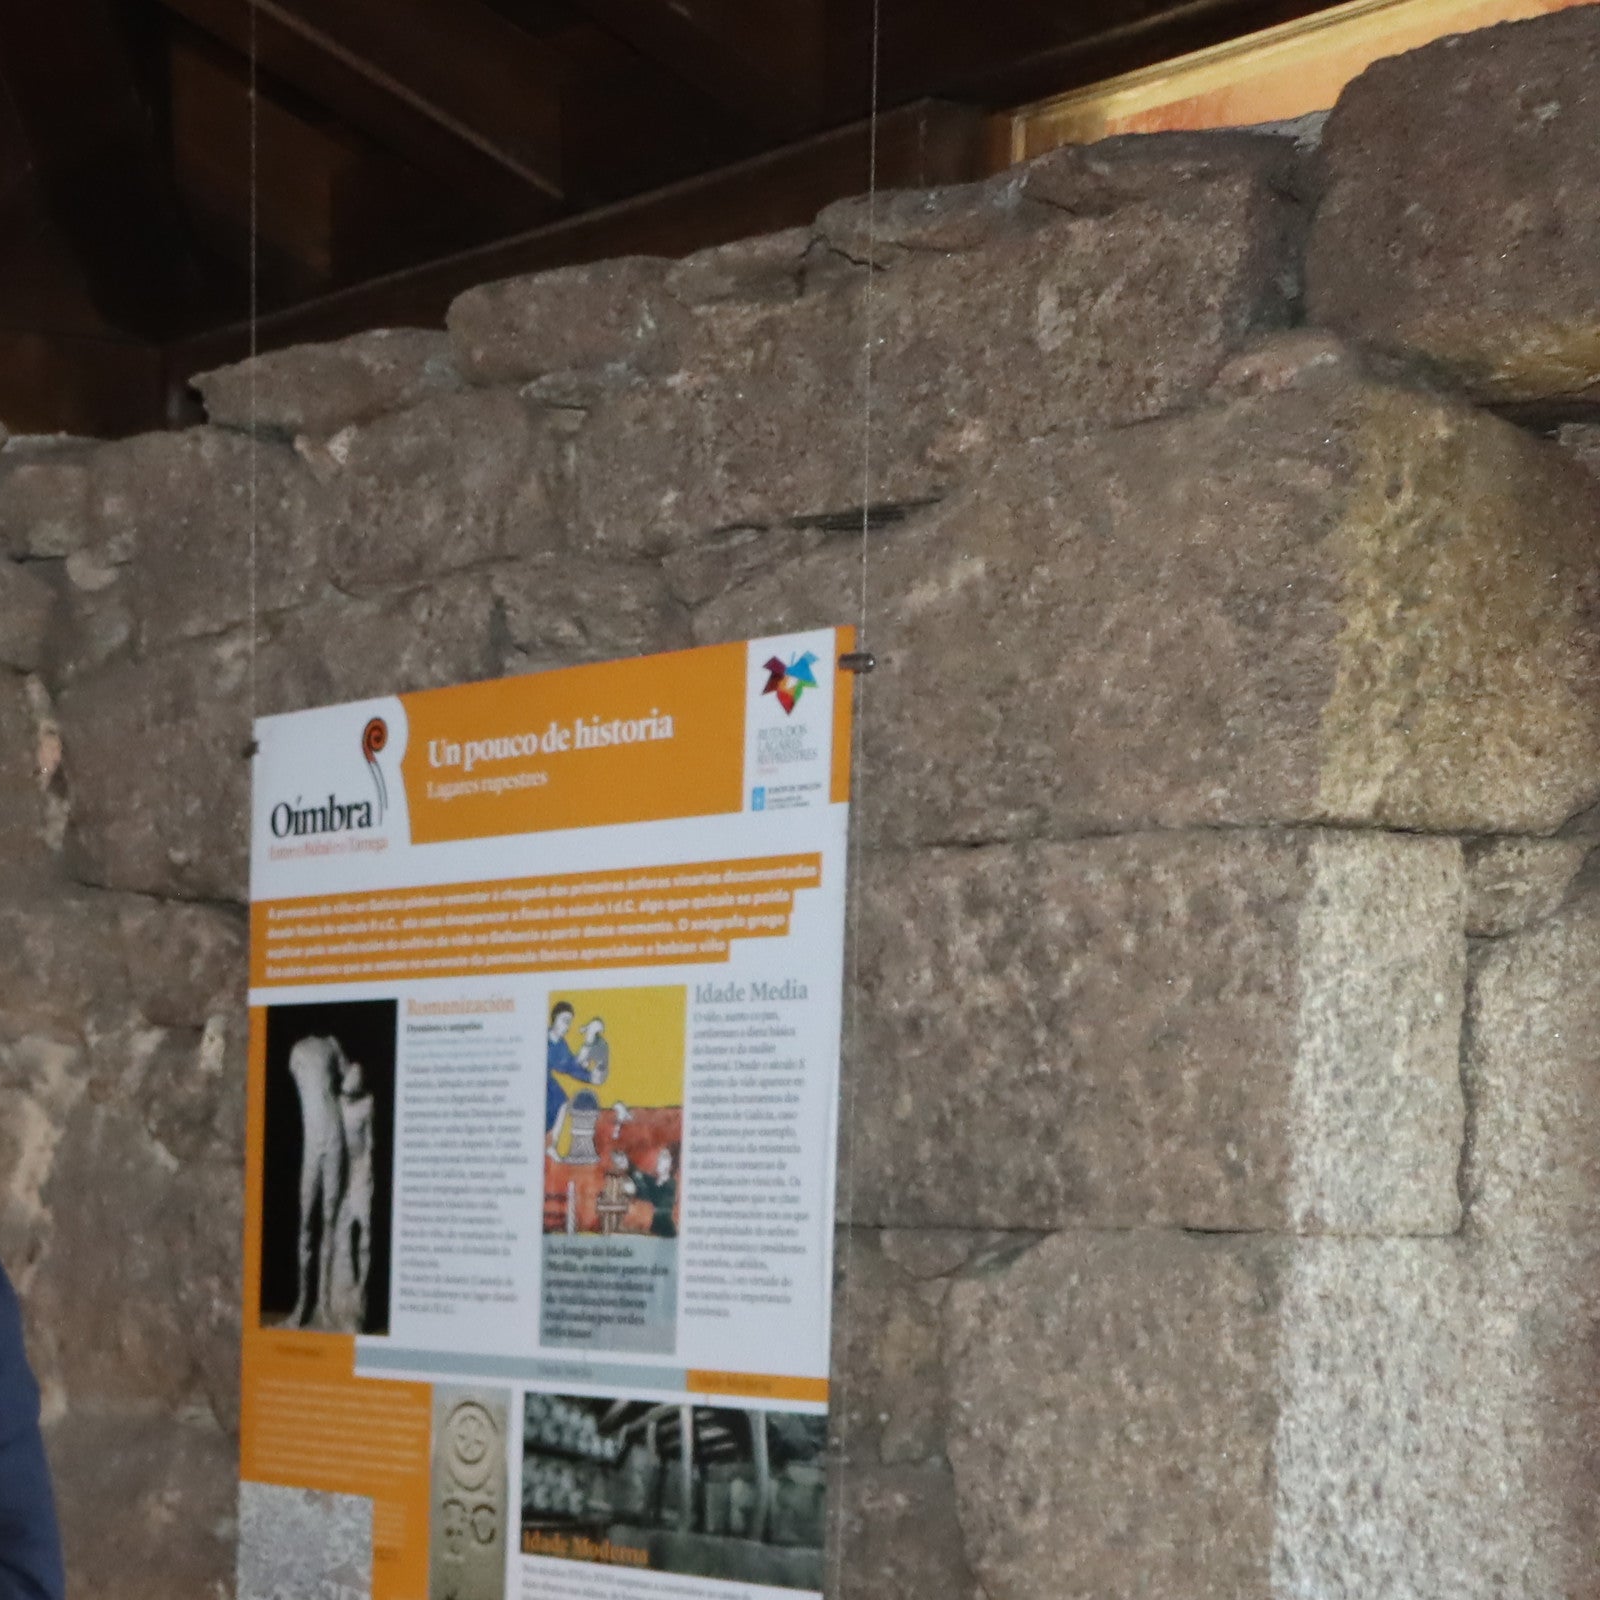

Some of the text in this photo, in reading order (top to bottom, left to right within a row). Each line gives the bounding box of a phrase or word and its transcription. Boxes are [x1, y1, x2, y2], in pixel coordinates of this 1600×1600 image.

[428, 707, 674, 772] Un pouco de historia
[427, 778, 479, 802] Lagares
[270, 793, 372, 838] Oímbra
[695, 978, 809, 1004] Idade Media
